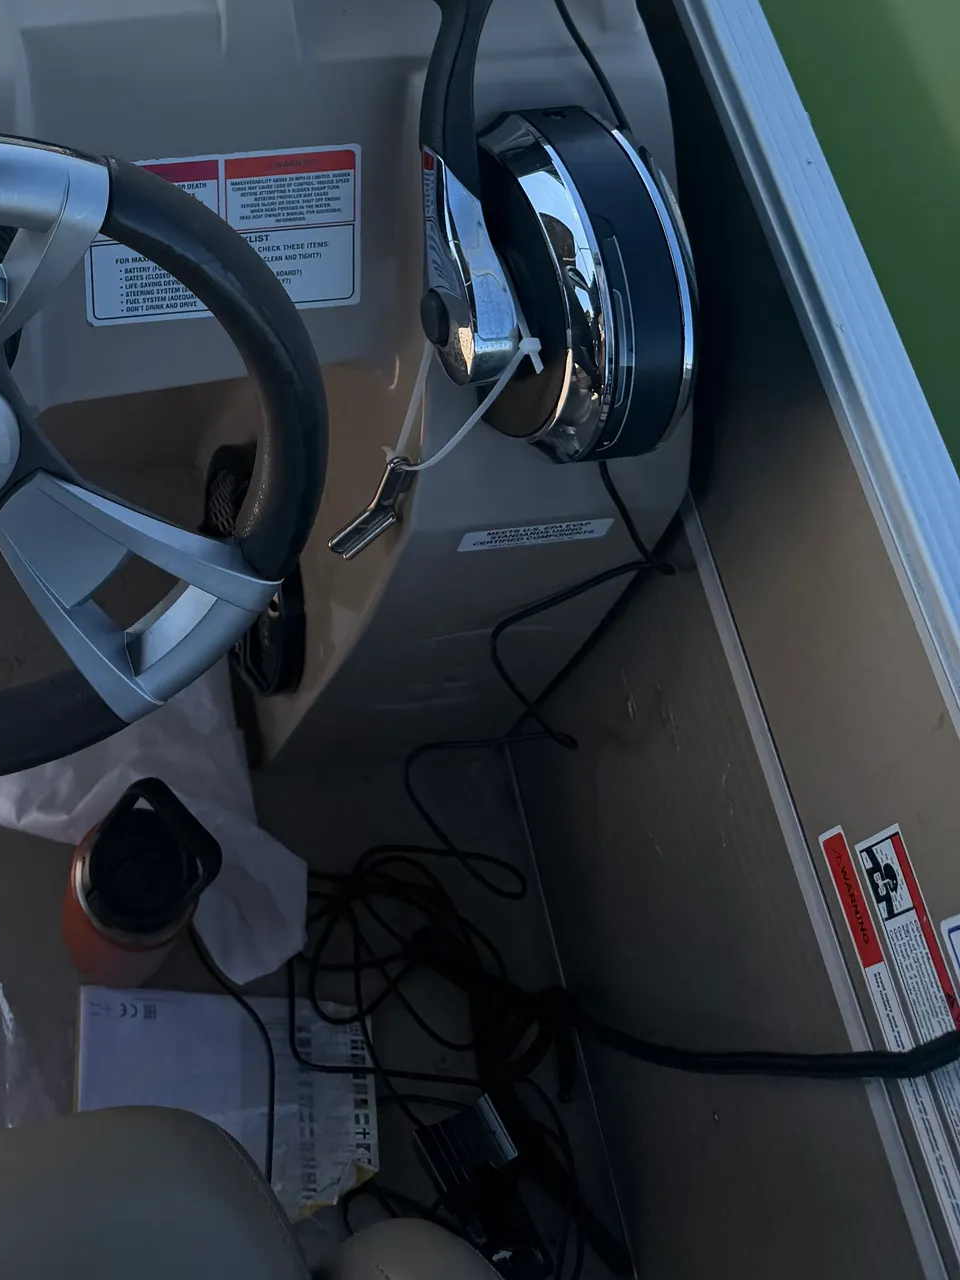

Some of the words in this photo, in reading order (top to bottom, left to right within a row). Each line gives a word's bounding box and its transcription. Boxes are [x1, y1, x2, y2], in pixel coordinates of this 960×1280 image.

[187, 182, 207, 190] DEATH
[258, 245, 281, 253] CHECK
[125, 266, 150, 274] BATTERY
[125, 281, 162, 289] LIFE-SAVING
[125, 289, 155, 297] STEERING
[142, 295, 166, 303] SYSTEM
[126, 305, 143, 313] DON'T
[840, 866, 870, 945] WARNING
